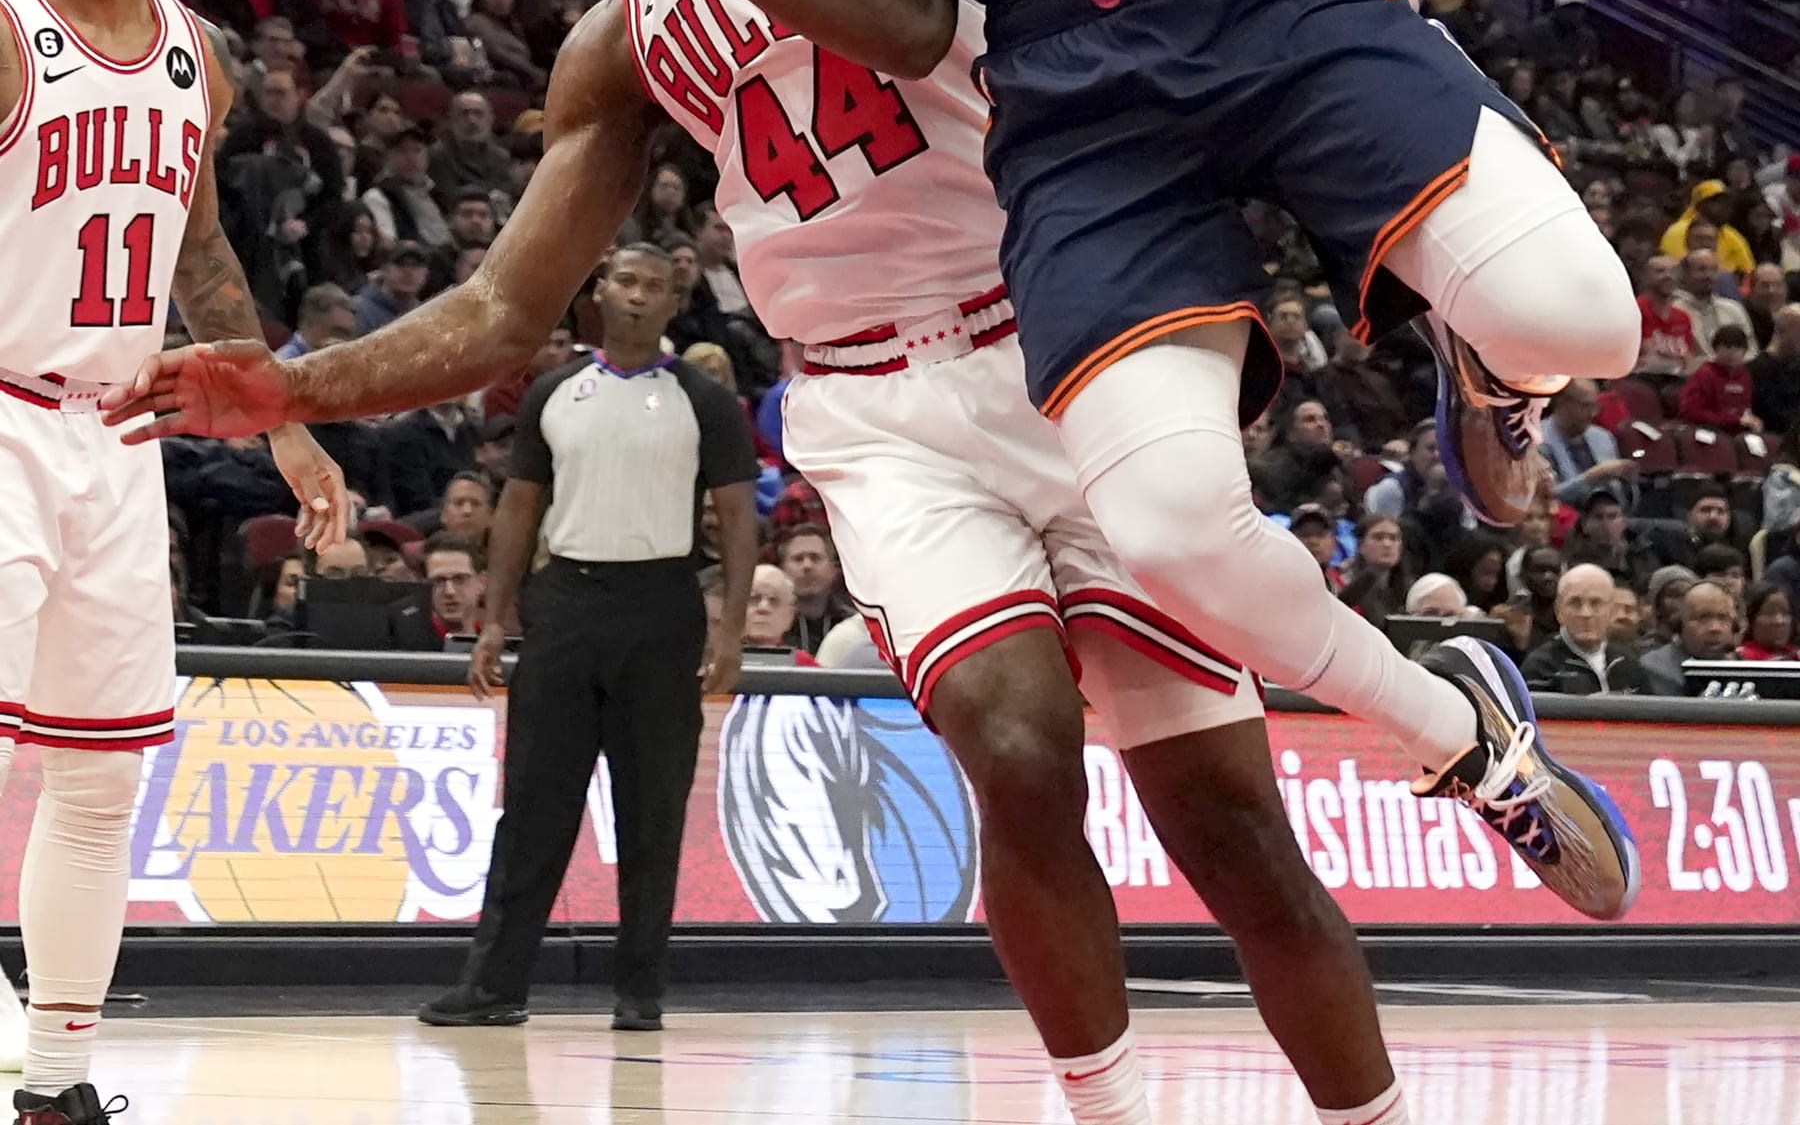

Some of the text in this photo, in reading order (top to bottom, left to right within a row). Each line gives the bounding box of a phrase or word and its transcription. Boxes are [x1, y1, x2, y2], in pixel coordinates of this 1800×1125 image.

[39, 33, 58, 53] 6
[31, 106, 202, 211] BULLS
[735, 44, 929, 222] 44
[70, 213, 155, 327] 11
[217, 720, 477, 750] LOS ANGELES
[130, 720, 488, 896] LAKERS
[1084, 744, 1172, 887] BA
[1276, 749, 1498, 890] istmas
[1649, 758, 1789, 892] 2:30
